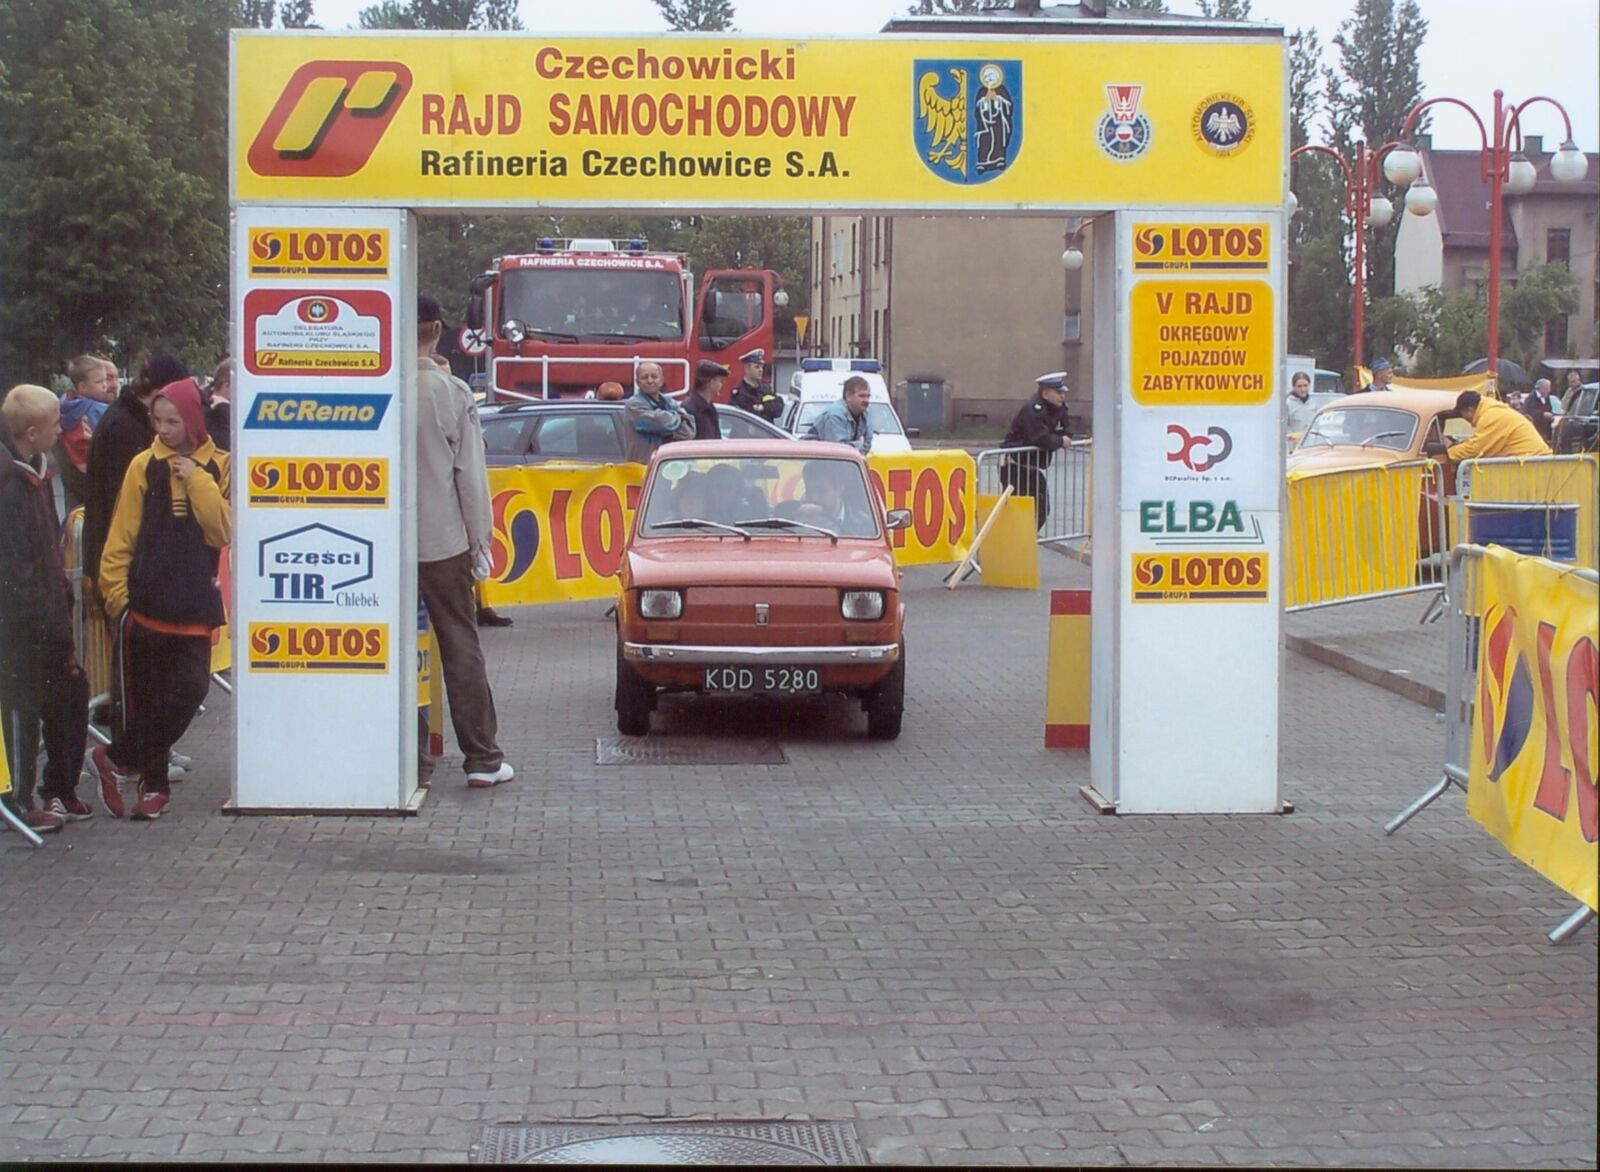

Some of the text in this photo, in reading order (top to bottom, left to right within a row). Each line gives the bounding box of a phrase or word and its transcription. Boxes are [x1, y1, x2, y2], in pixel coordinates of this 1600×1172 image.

[535, 47, 796, 80] Czechowicki
[421, 93, 856, 138] RAJD SAMOCHODOWY
[421, 149, 851, 179] Rafineria Czechowice S.A.
[288, 232, 382, 262] LOTOS
[1171, 228, 1263, 257] LOTOS
[281, 267, 307, 275] GRUPA
[519, 258, 664, 269] RAFINERIA CZECHOWICE S.A.
[1155, 292, 1253, 315] V RAJD
[1159, 325, 1249, 346] OKRĘGOWY
[278, 358, 377, 368] Rafineria Czechowice S.A.
[1160, 345, 1247, 367] POJAZDÓW
[1143, 374, 1264, 392] ZABYTKOWYCH
[256, 399, 376, 422] RCRemo
[287, 462, 381, 492] LOTOS
[279, 496, 306, 504] GRUPA
[1140, 500, 1245, 533] ELBA
[549, 485, 644, 581] LO
[1171, 557, 1262, 587] LOTOS
[269, 573, 325, 599] TIR
[1163, 591, 1188, 599] GRUPA
[335, 591, 380, 608] Chlebek
[288, 627, 381, 657] LOTOS
[280, 661, 307, 669] GRUPA
[705, 668, 819, 690] KDD 5280
